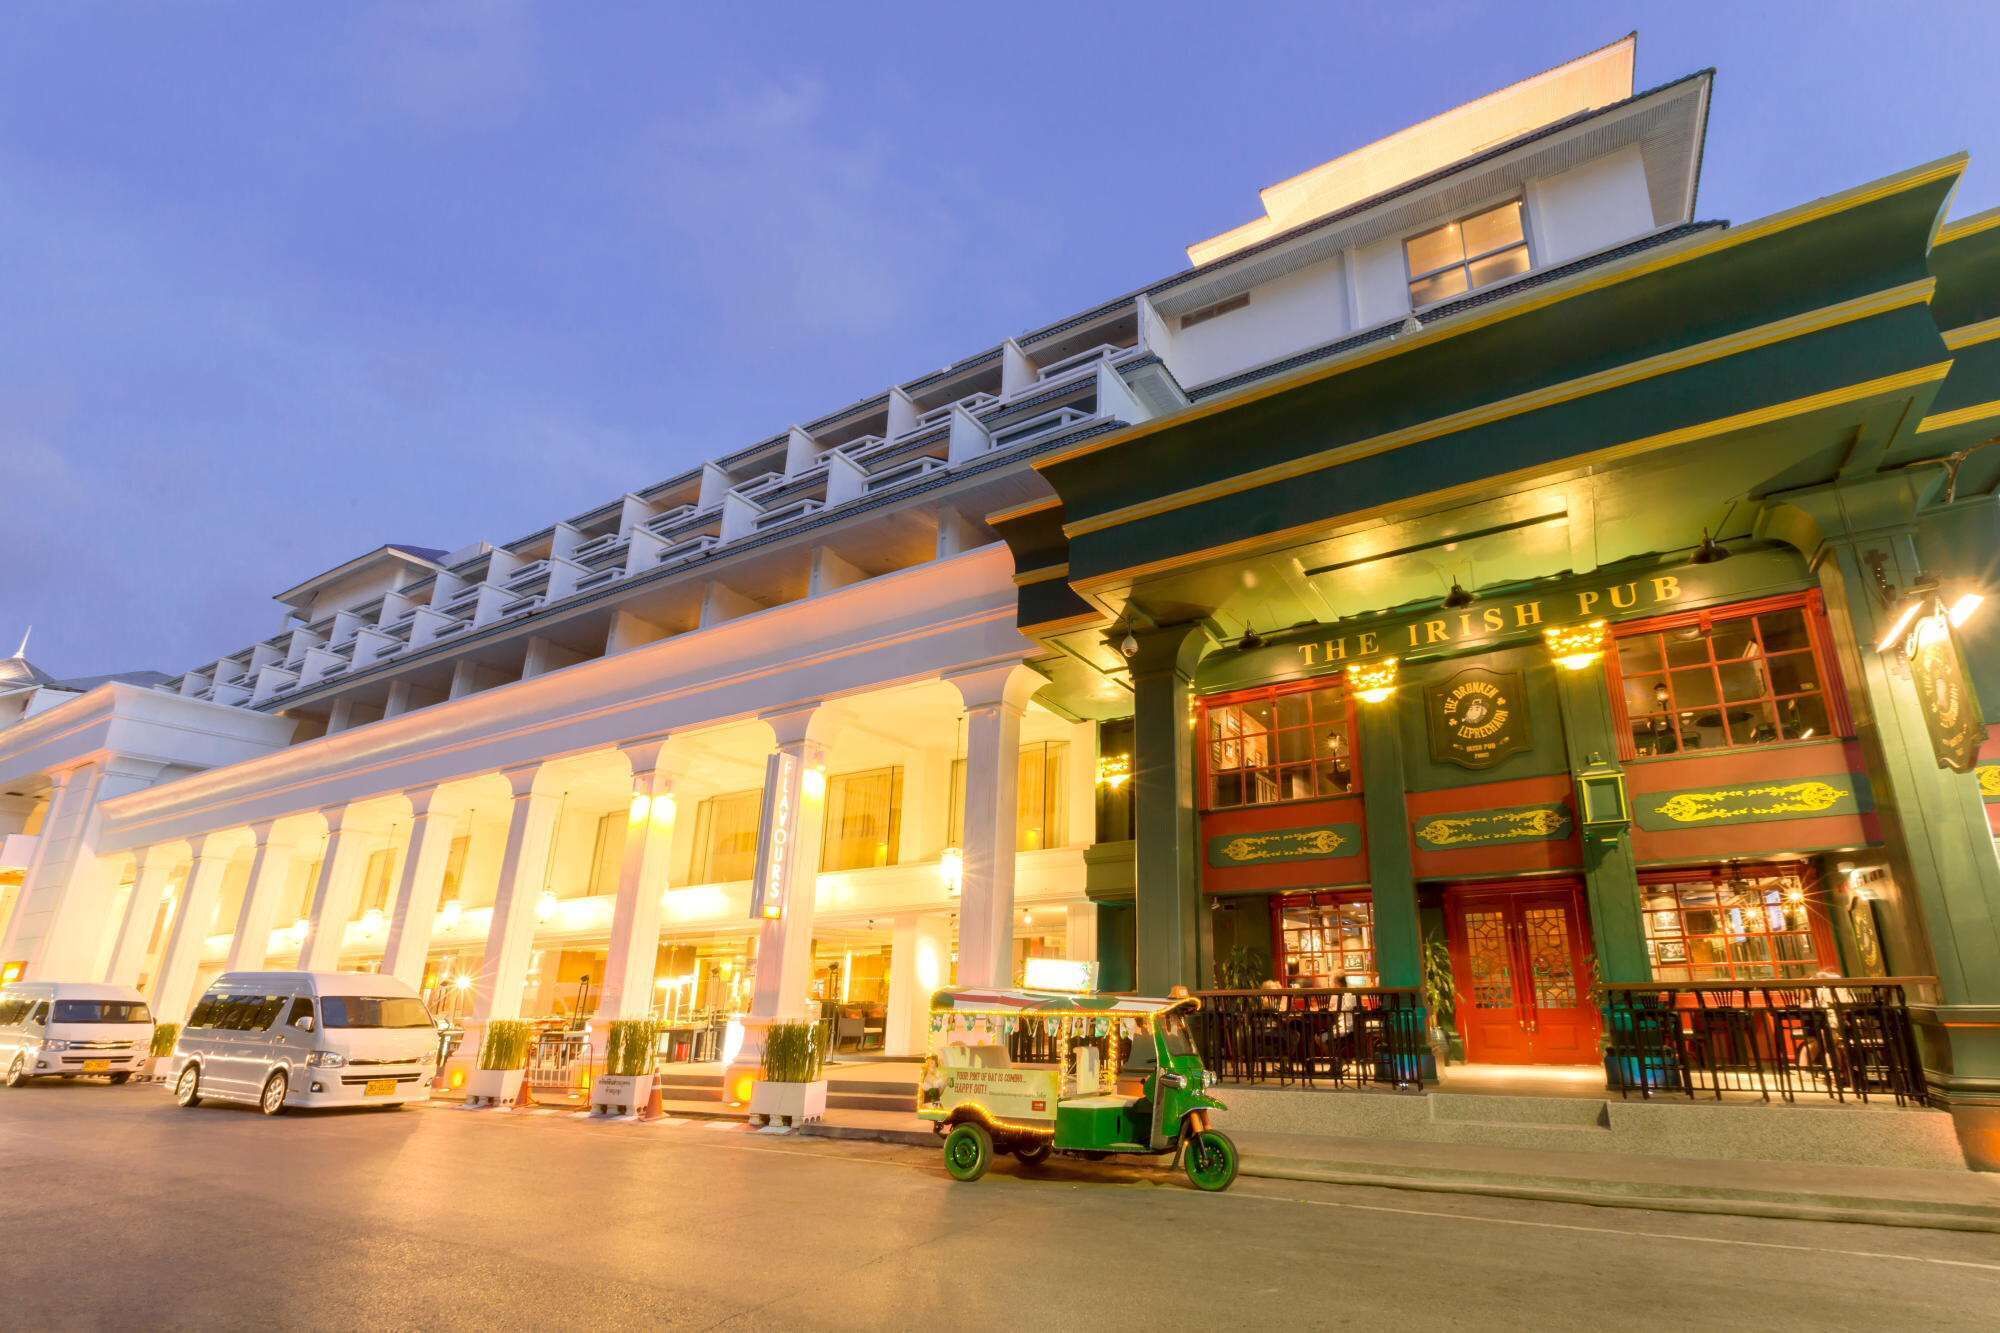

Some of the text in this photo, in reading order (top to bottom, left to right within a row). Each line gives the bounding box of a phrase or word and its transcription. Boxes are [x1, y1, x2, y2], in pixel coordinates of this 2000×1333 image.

[1298, 576, 1682, 666] THE IRISH PUB
[1444, 682, 1499, 714] THE DRUNKEN
[1457, 710, 1509, 739] LEPRECHAUN
[770, 760, 793, 899] FLAVOURS
